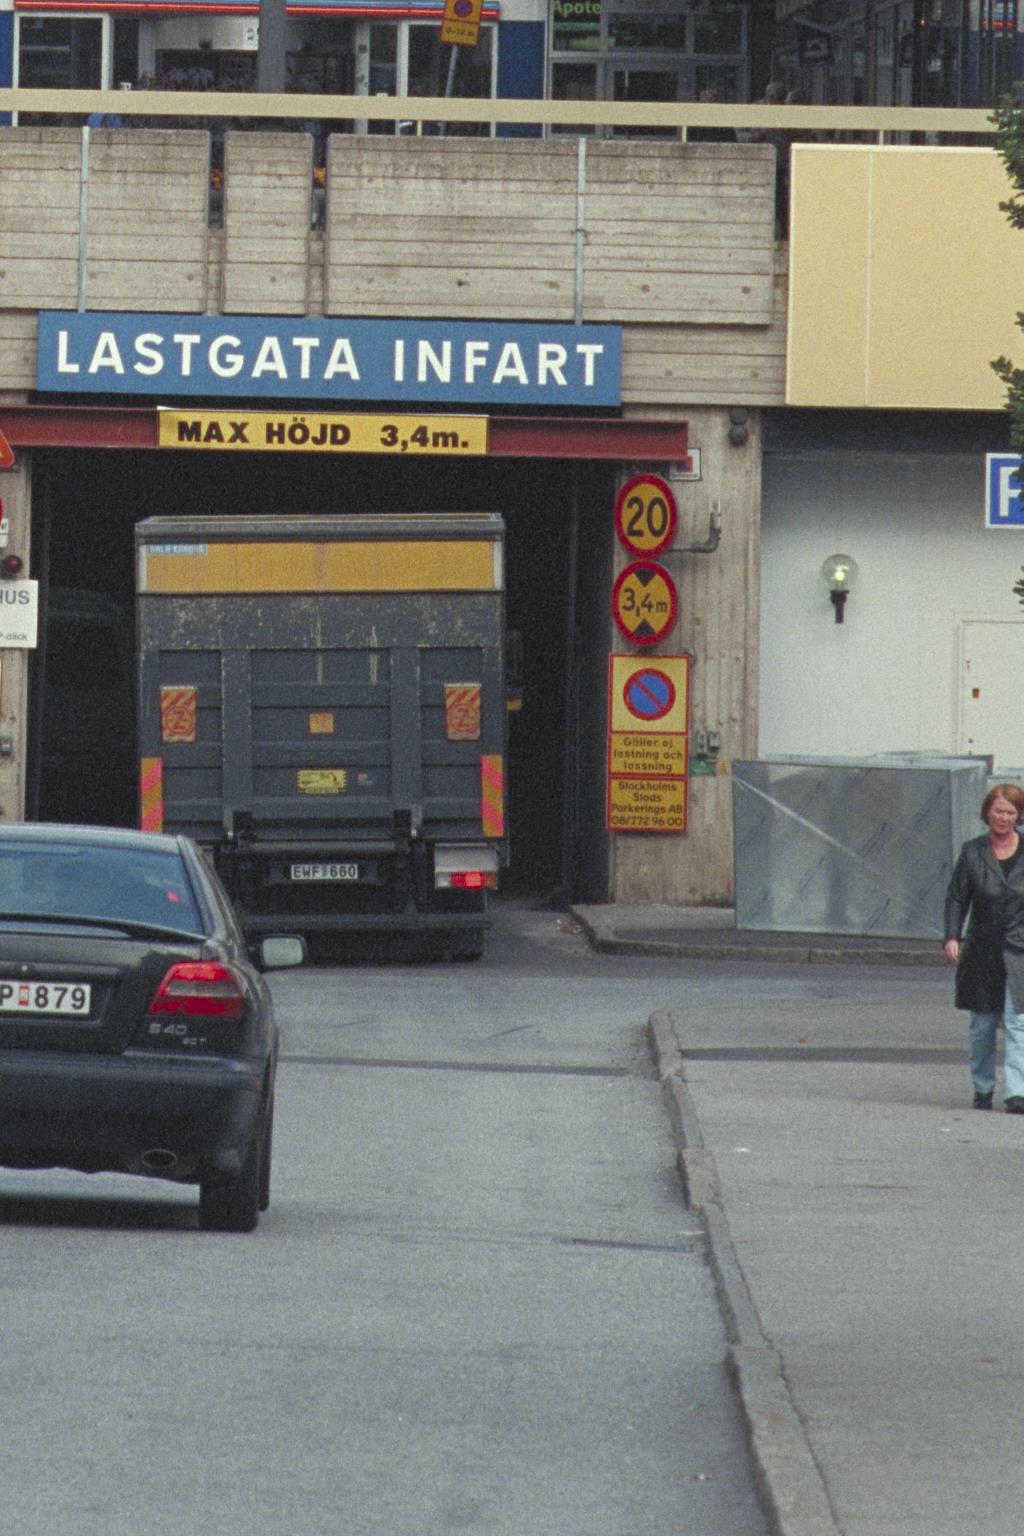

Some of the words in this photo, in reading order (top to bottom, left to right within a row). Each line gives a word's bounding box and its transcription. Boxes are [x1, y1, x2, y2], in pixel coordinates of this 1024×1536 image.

[57, 330, 361, 382] LASTGATA
[394, 339, 604, 387] INFART
[177, 421, 249, 444] MAX
[265, 416, 352, 447] HÖJD
[626, 495, 669, 538] 20
[663, 751, 684, 761] och
[619, 781, 677, 792] Stockholms
[669, 805, 683, 814] AB
[34, 985, 87, 1011] 879
